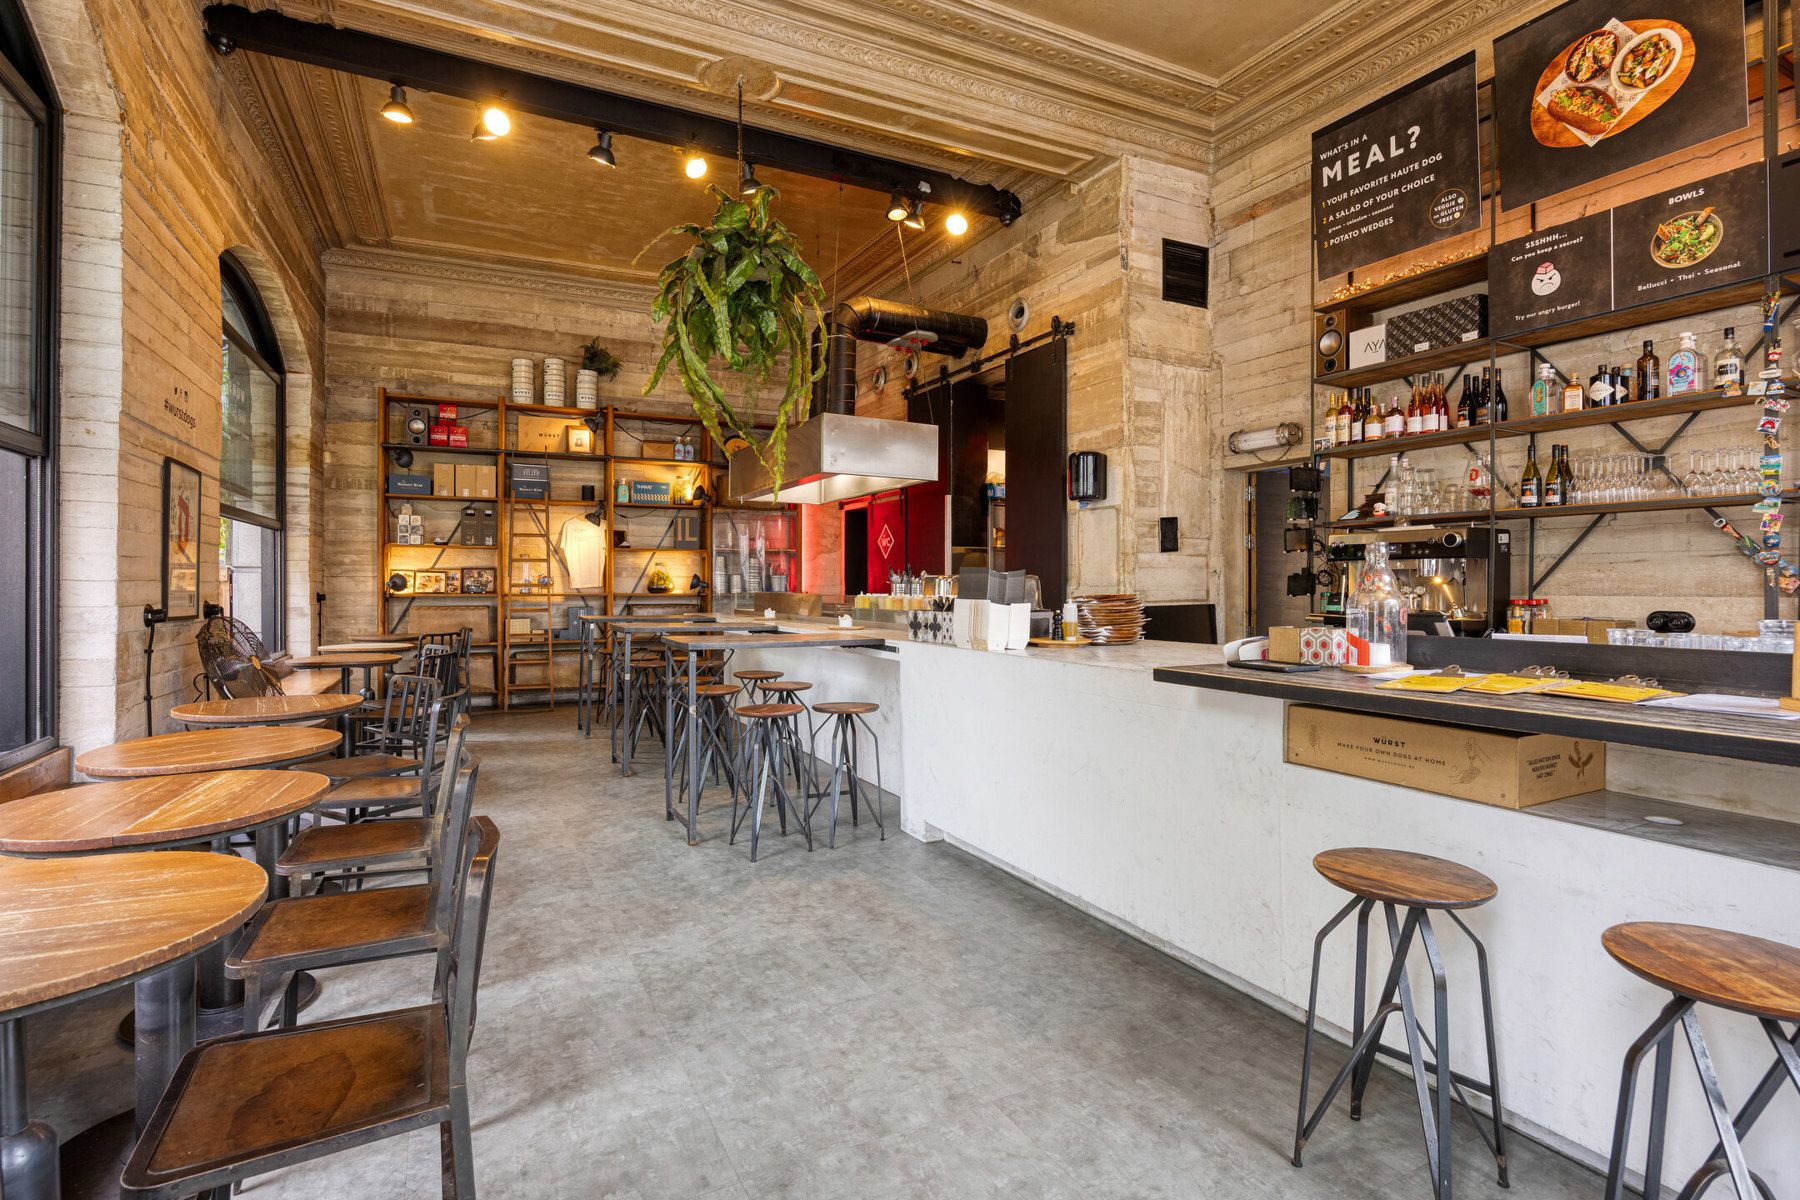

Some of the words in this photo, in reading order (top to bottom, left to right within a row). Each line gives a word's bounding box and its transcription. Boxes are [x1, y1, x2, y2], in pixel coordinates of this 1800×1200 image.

[1320, 141, 1348, 160] WHAT'S
[1350, 137, 1359, 147] IN
[1361, 134, 1368, 142] A
[1322, 125, 1421, 188] MEAL?
[1326, 192, 1348, 206] YOUR
[1350, 175, 1388, 197] FAVORITE
[1390, 162, 1420, 180] HAUTE
[1422, 152, 1443, 167] DOG
[1322, 217, 1327, 225] 2
[1335, 204, 1361, 219] SALAD
[1363, 198, 1374, 208] OF
[1375, 188, 1399, 203] YOUR
[1401, 173, 1435, 193] CHOICE
[1433, 201, 1456, 212] VEGGIE
[1440, 193, 1457, 203] ALSO
[1668, 188, 1705, 205] BOWLS
[1328, 224, 1342, 234] green
[1346, 213, 1368, 226] coleslaw
[1371, 203, 1394, 216] seasonal
[1440, 204, 1464, 217] GLUTEN
[1323, 241, 1328, 249] 3
[1329, 229, 1359, 247] POTATO
[1360, 216, 1394, 234] WEDGES
[1524, 251, 1536, 260] you
[1536, 246, 1553, 255] keep
[1559, 236, 1584, 248] secret?
[1637, 279, 1667, 291] Bellucci
[1677, 272, 1695, 281] Thai
[1704, 261, 1741, 275] Seasonal
[1537, 307, 1556, 316] angry
[1373, 735, 1406, 748] WÜRST
[1337, 742, 1354, 750] MAKE
[1356, 745, 1373, 753] YOUR
[1375, 748, 1391, 756] OWN
[1393, 751, 1412, 760] DOGS
[1425, 758, 1446, 766] HOME
